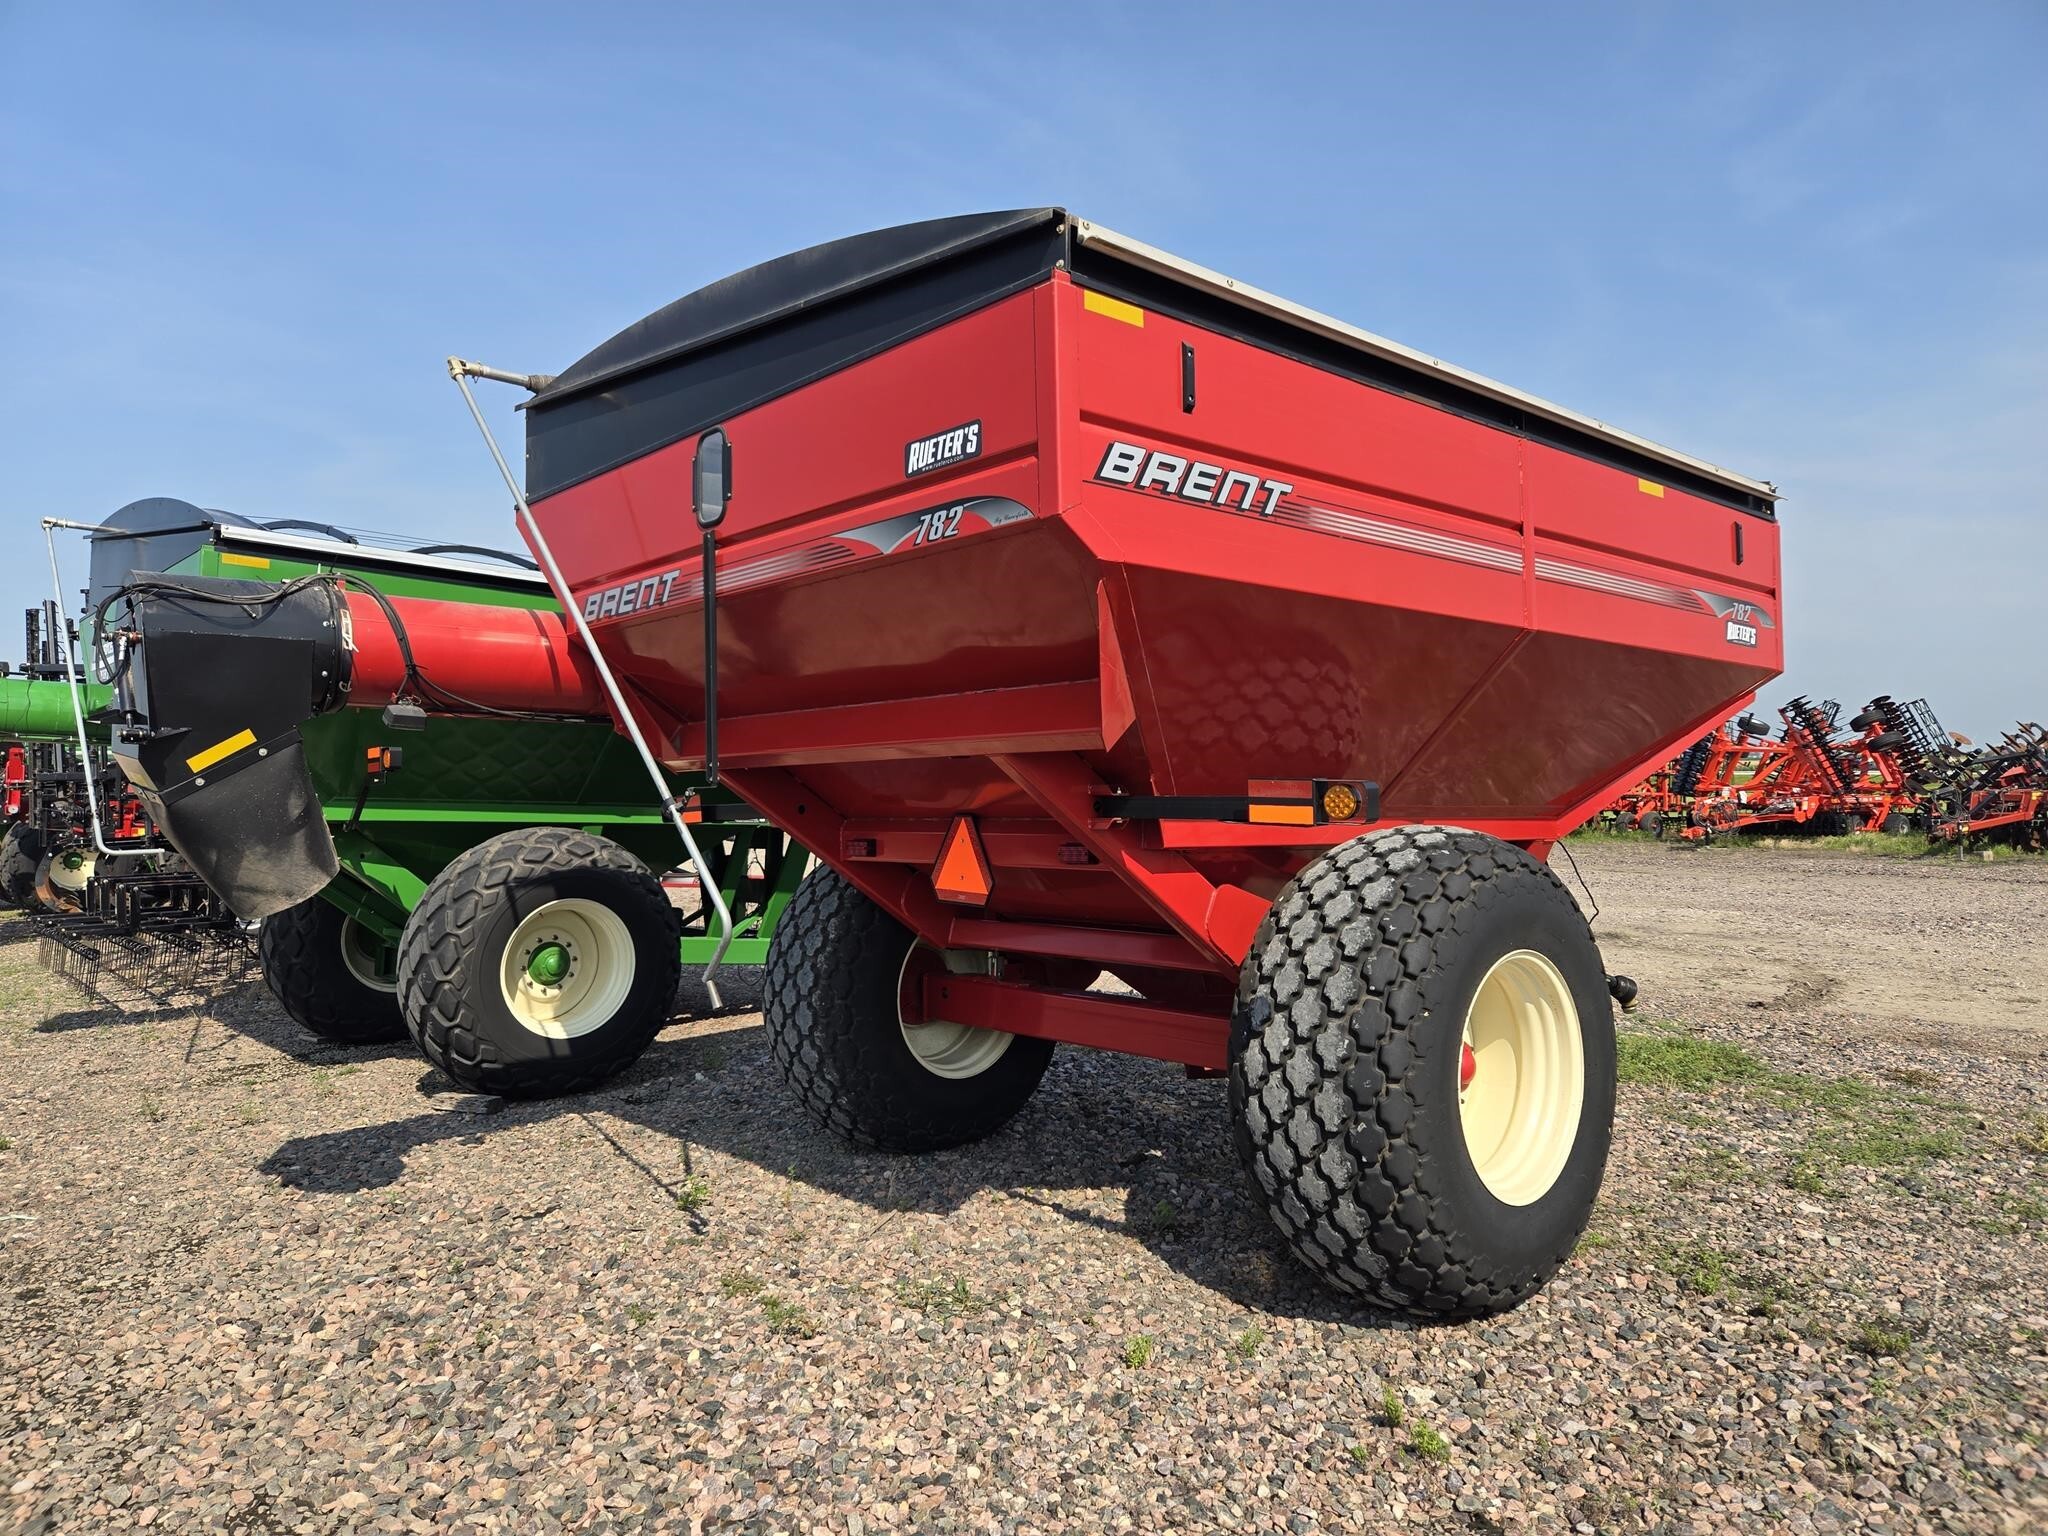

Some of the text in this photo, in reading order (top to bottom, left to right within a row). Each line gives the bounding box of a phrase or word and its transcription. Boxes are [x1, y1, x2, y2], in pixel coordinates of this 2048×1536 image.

[907, 423, 979, 475] RUETER'S
[1093, 440, 1295, 517] BRENT
[914, 504, 965, 546] 782
[583, 569, 681, 623] BRENT
[1731, 602, 1752, 622] 782
[1726, 621, 1757, 645] RUETER'S
